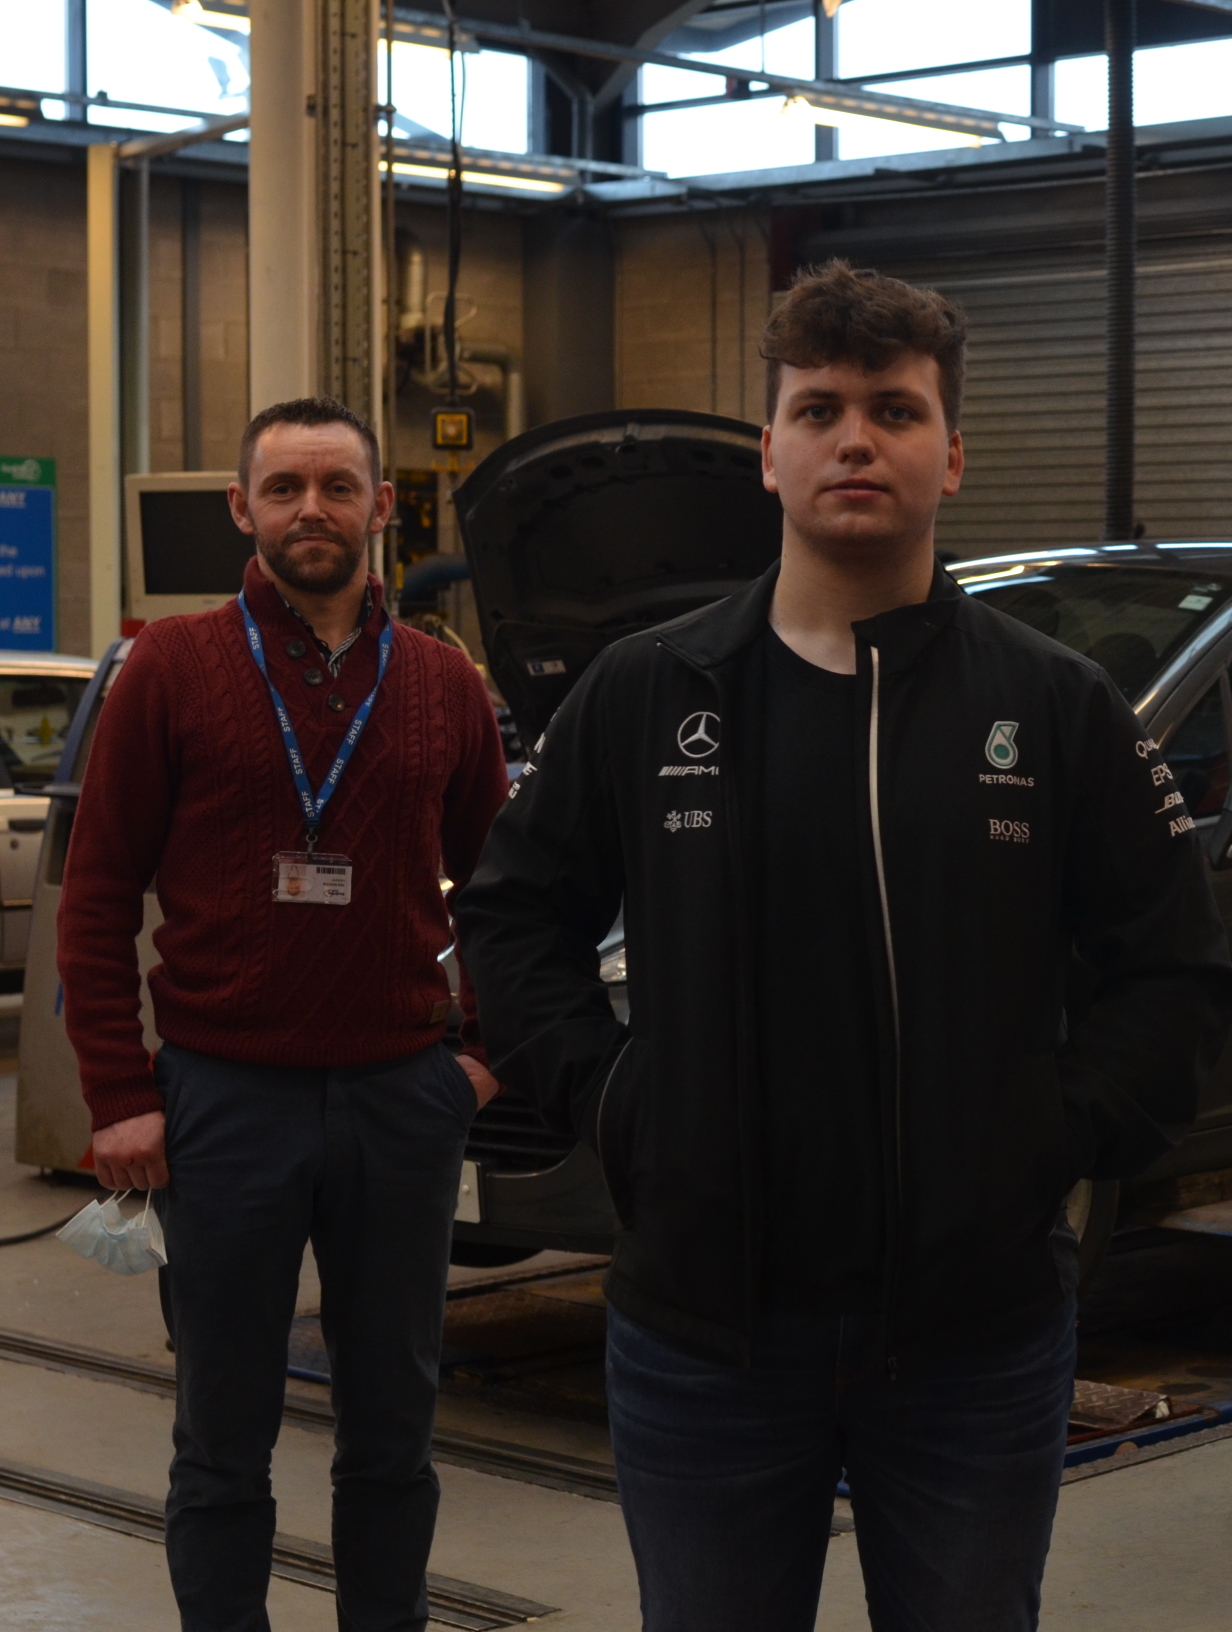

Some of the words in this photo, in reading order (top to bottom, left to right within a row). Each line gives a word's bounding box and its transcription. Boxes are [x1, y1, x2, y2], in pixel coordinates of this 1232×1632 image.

[249, 627, 260, 650] STAFF
[277, 707, 290, 732] STAFF
[347, 719, 362, 745] STAFF
[290, 748, 303, 774] STAFF
[328, 758, 344, 784] STAFF
[979, 774, 1034, 786] PETRONAS
[302, 791, 315, 817] STAFF
[684, 810, 712, 828] UBS
[988, 819, 1030, 838] BOSS
